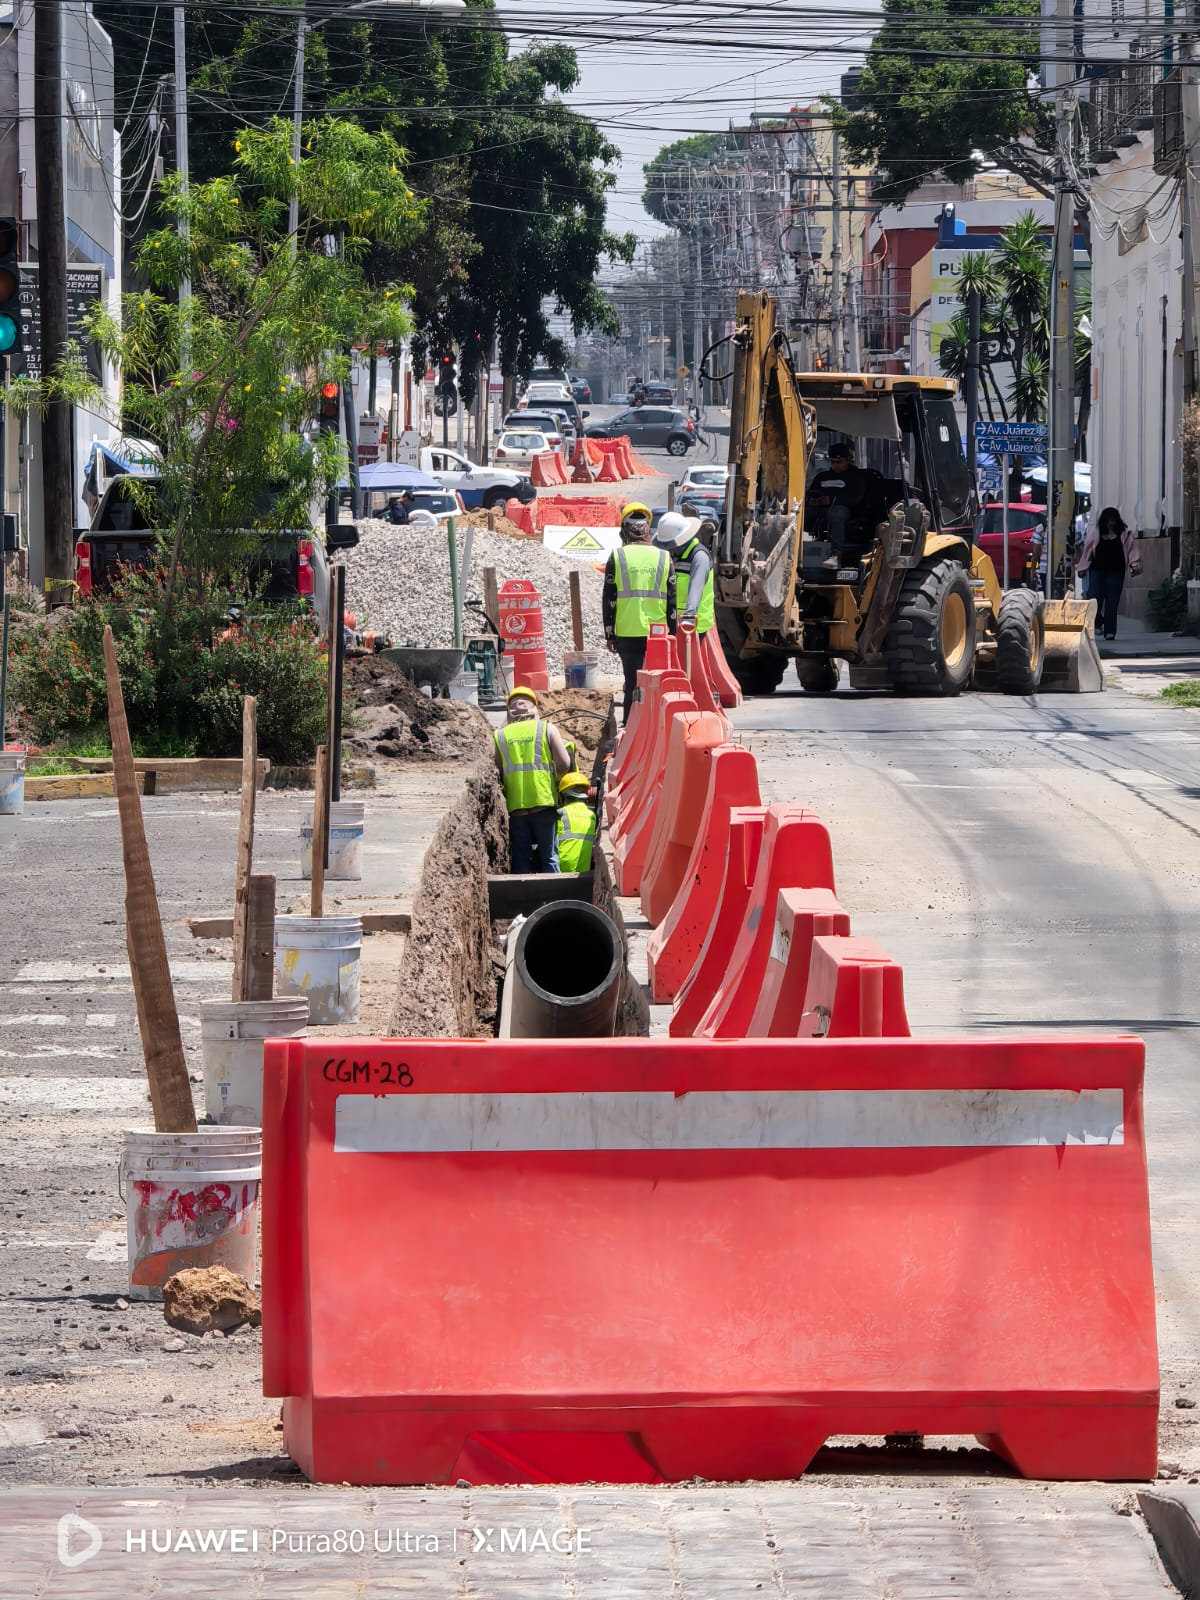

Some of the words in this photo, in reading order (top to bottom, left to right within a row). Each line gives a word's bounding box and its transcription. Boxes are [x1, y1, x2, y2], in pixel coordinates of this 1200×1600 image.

[987, 424, 1001, 435] Av.
[1002, 423, 1035, 436] Juárez
[989, 441, 1003, 451] Av.
[1003, 441, 1034, 452] Juárez
